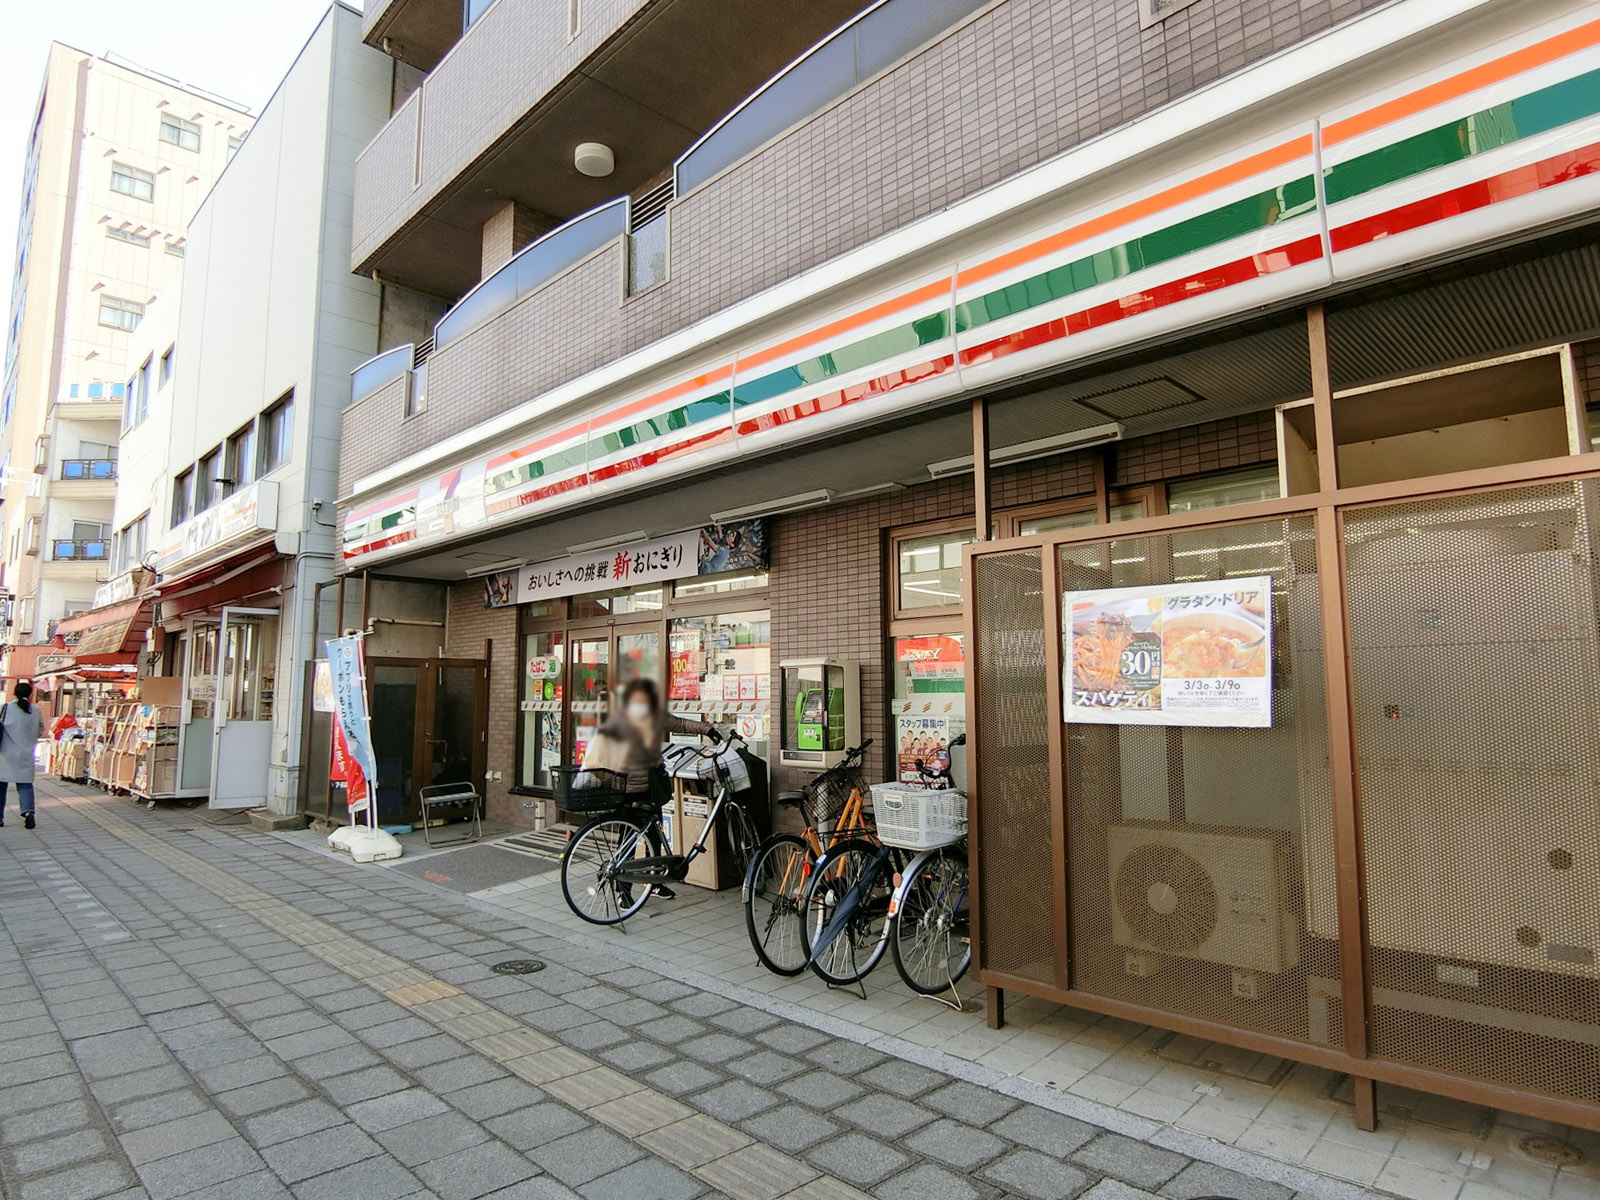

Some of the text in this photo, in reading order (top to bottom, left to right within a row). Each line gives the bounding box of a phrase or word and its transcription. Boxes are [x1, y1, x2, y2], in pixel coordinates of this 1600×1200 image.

[528, 544, 683, 591] おいしさへの挑戦 新おにぎり
[1167, 591, 1259, 610] グラタン・ドリア
[530, 660, 547, 673] たばこ
[1075, 690, 1149, 707] スパゲティ
[899, 718, 947, 729] スタッフ募集中!
